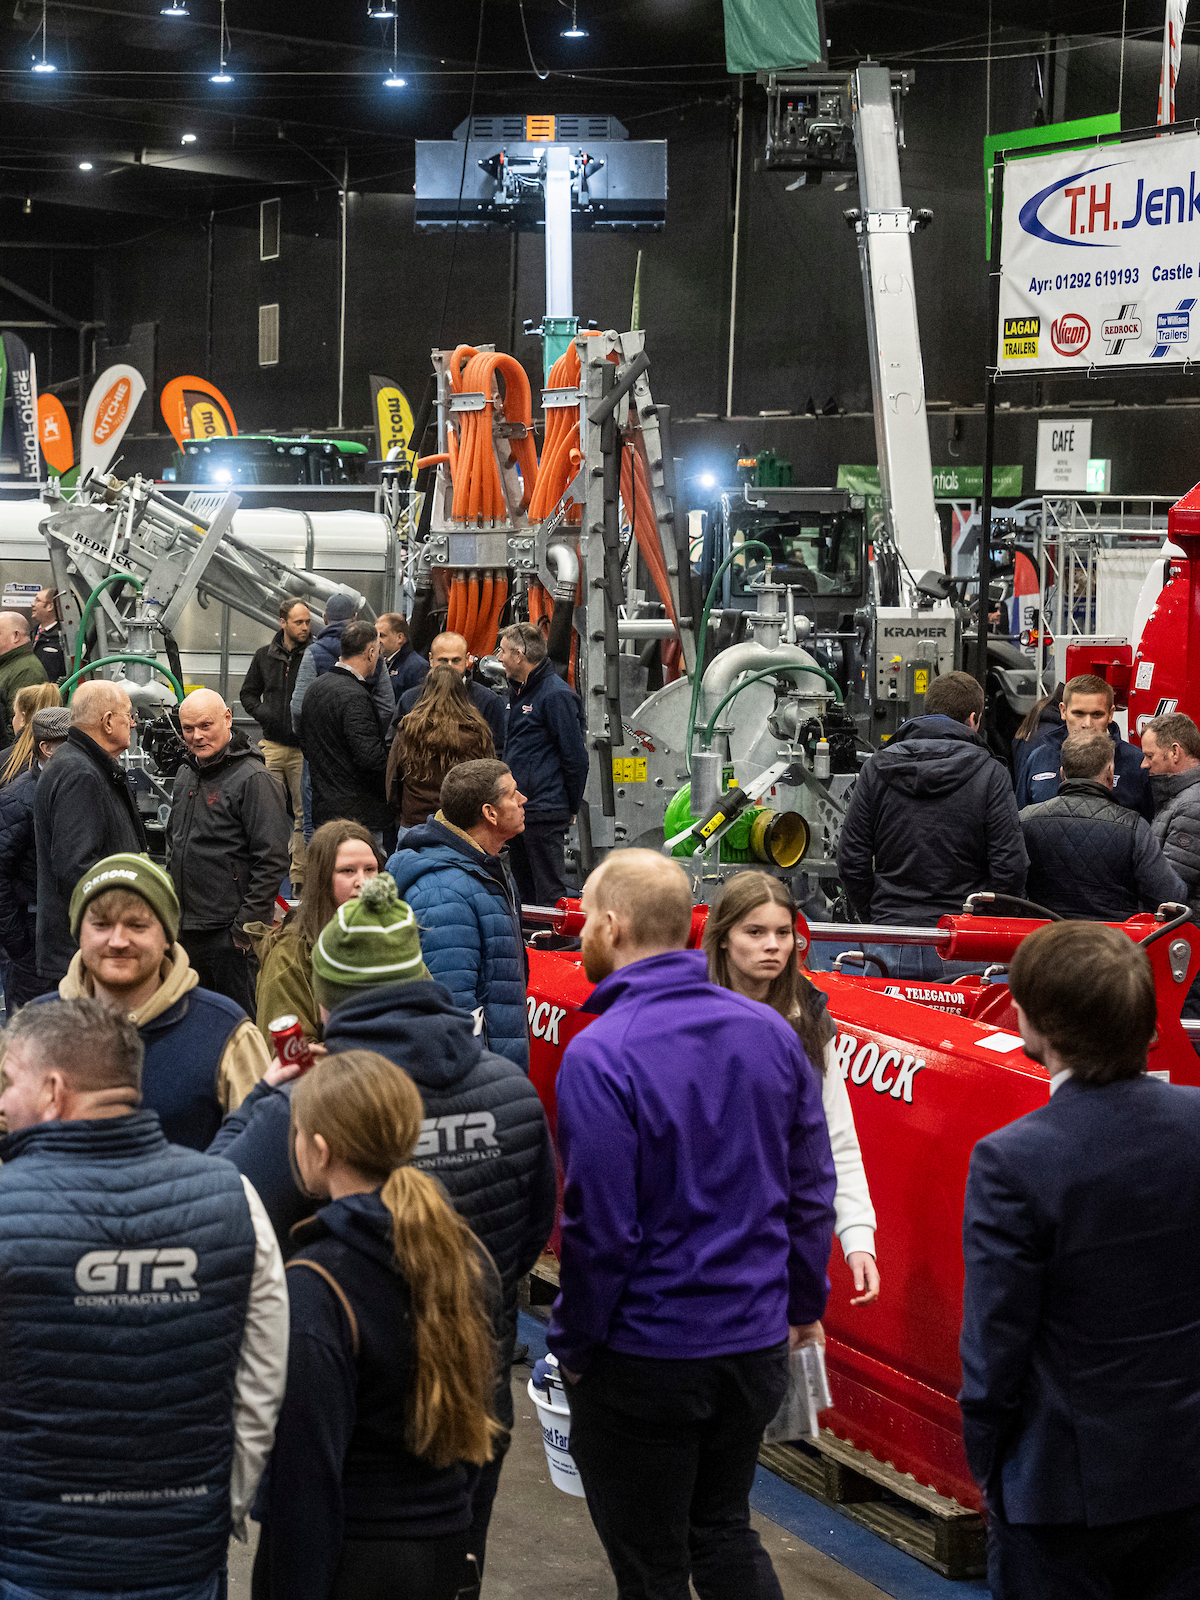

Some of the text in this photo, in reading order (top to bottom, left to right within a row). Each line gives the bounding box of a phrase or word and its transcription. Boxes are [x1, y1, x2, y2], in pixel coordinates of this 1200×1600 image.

[1064, 182, 1118, 235] T.H.
[1028, 263, 1193, 295] Ayr: 01292 619193 Castle
[1005, 320, 1039, 335] LAGAN
[1051, 318, 1086, 345] Vicon
[1104, 323, 1139, 335] REDROCK
[1158, 328, 1188, 341] Trailers
[1005, 342, 1036, 356] TRAILERS
[95, 382, 128, 440] RITCHIE
[1052, 424, 1075, 452] CAFÉ
[884, 627, 947, 638] KRAMER
[92, 869, 138, 885] KRONE
[905, 987, 966, 1005] TELEGATOR
[75, 1247, 198, 1293] GTR
[74, 1290, 200, 1307] CONTRACTS LTD
